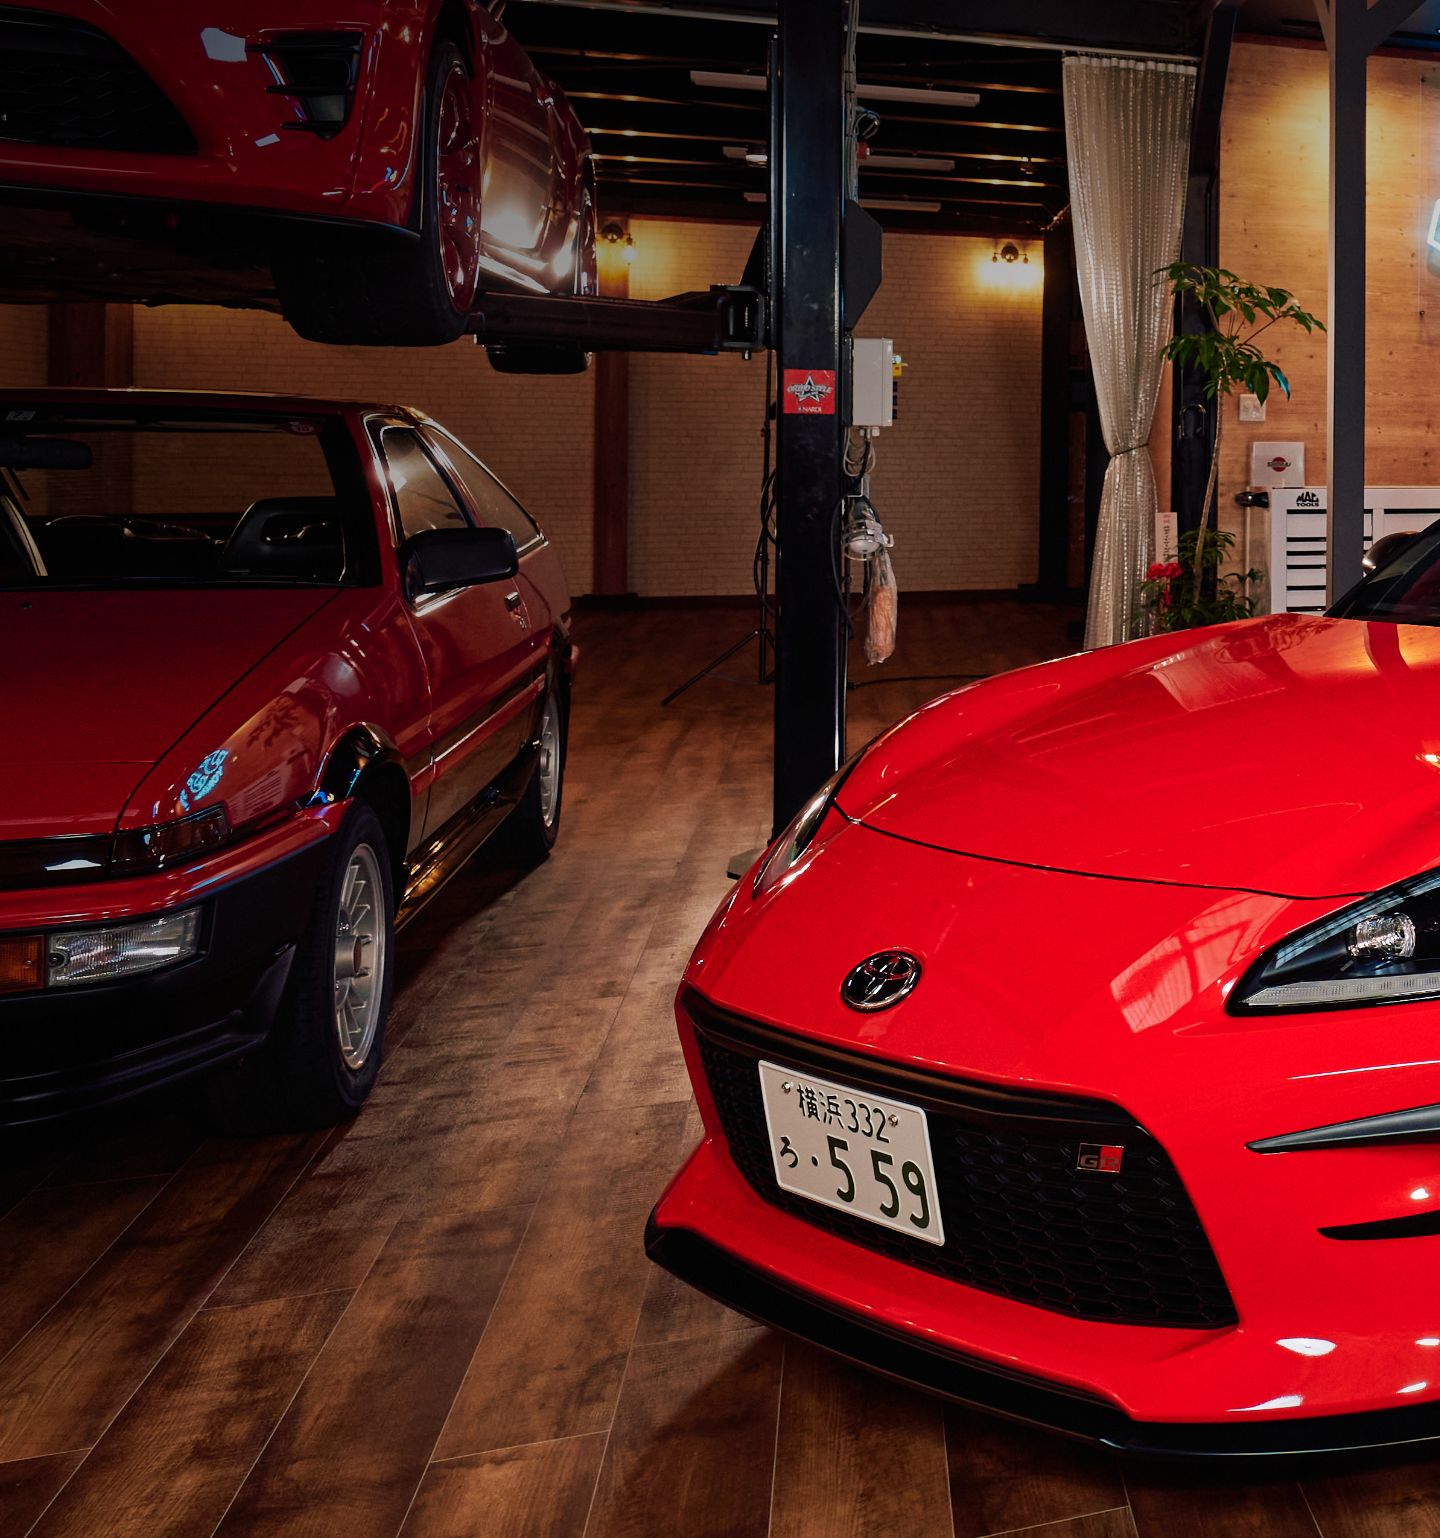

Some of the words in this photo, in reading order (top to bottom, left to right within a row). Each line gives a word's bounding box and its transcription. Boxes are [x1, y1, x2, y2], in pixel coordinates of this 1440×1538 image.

[1296, 491, 1320, 503] MAC
[780, 1136, 799, 1168] ろ
[1080, 1154, 1119, 1169] GR
